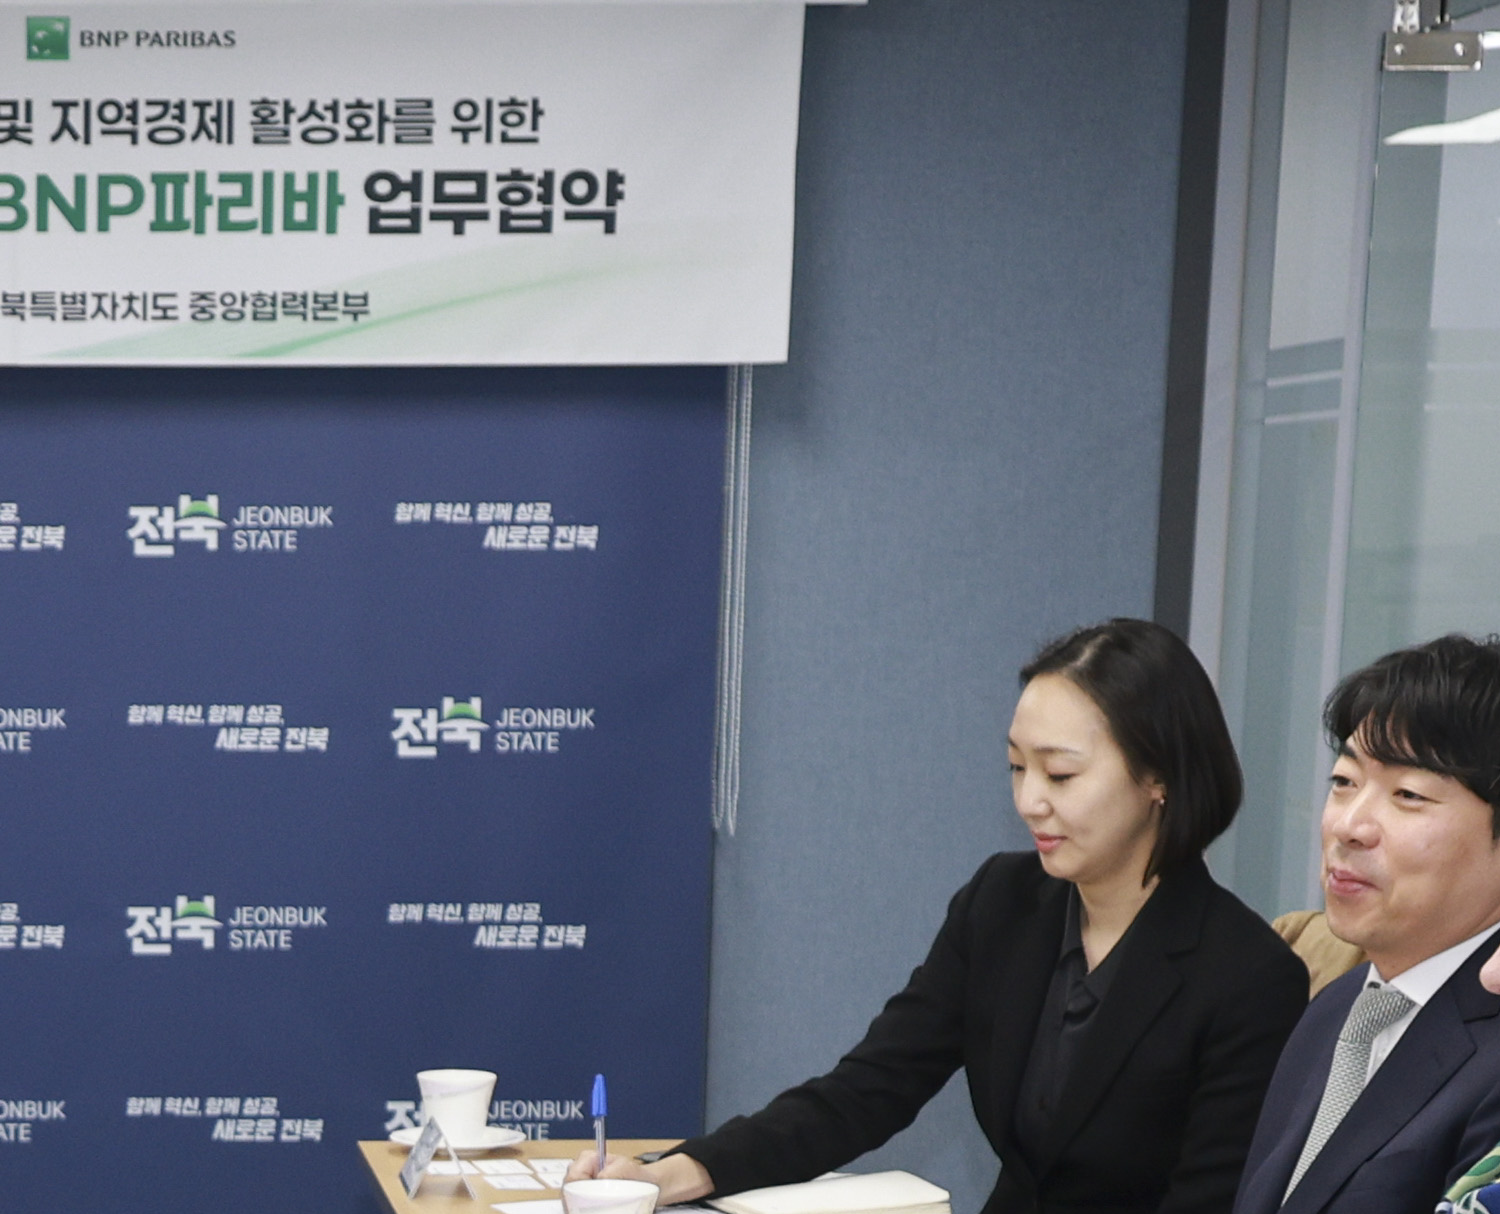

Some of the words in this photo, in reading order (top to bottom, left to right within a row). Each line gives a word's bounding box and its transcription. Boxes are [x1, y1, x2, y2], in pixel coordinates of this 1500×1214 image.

[80, 31, 128, 47] BNP
[136, 31, 236, 47] PARIBAS
[50, 98, 234, 146] 지역경제
[250, 98, 436, 145] 활성화를
[451, 97, 544, 144] 위한
[363, 168, 625, 236] 업무협약
[190, 292, 370, 322] 중앙협력본부
[233, 506, 333, 527] JEONBUK
[395, 501, 431, 523] 함께
[476, 501, 514, 523] 함께
[127, 495, 225, 557] 전북
[483, 525, 549, 550] 새로운
[552, 525, 598, 550] 전북
[19, 526, 65, 550] 전북
[233, 530, 297, 551] STATE
[128, 704, 163, 725] 함께
[208, 704, 246, 725] 함께
[496, 708, 594, 728] JEONBUK
[215, 726, 281, 752] 새로운
[284, 726, 329, 752] 전북
[391, 697, 489, 758] 전북
[496, 732, 559, 753] STATE
[229, 906, 327, 926] JEONBUK
[388, 902, 423, 923] 함께
[467, 902, 504, 923] 함께
[125, 895, 223, 955] 전북
[20, 925, 65, 949] 전북
[229, 929, 292, 950] STATE
[474, 925, 538, 949] 새로운
[541, 925, 586, 949] 전북
[126, 1096, 161, 1116] 함께
[205, 1096, 242, 1116] 함께
[488, 1100, 584, 1119] JEONBUK
[212, 1118, 276, 1142] 새로운
[279, 1118, 323, 1142] 전북
